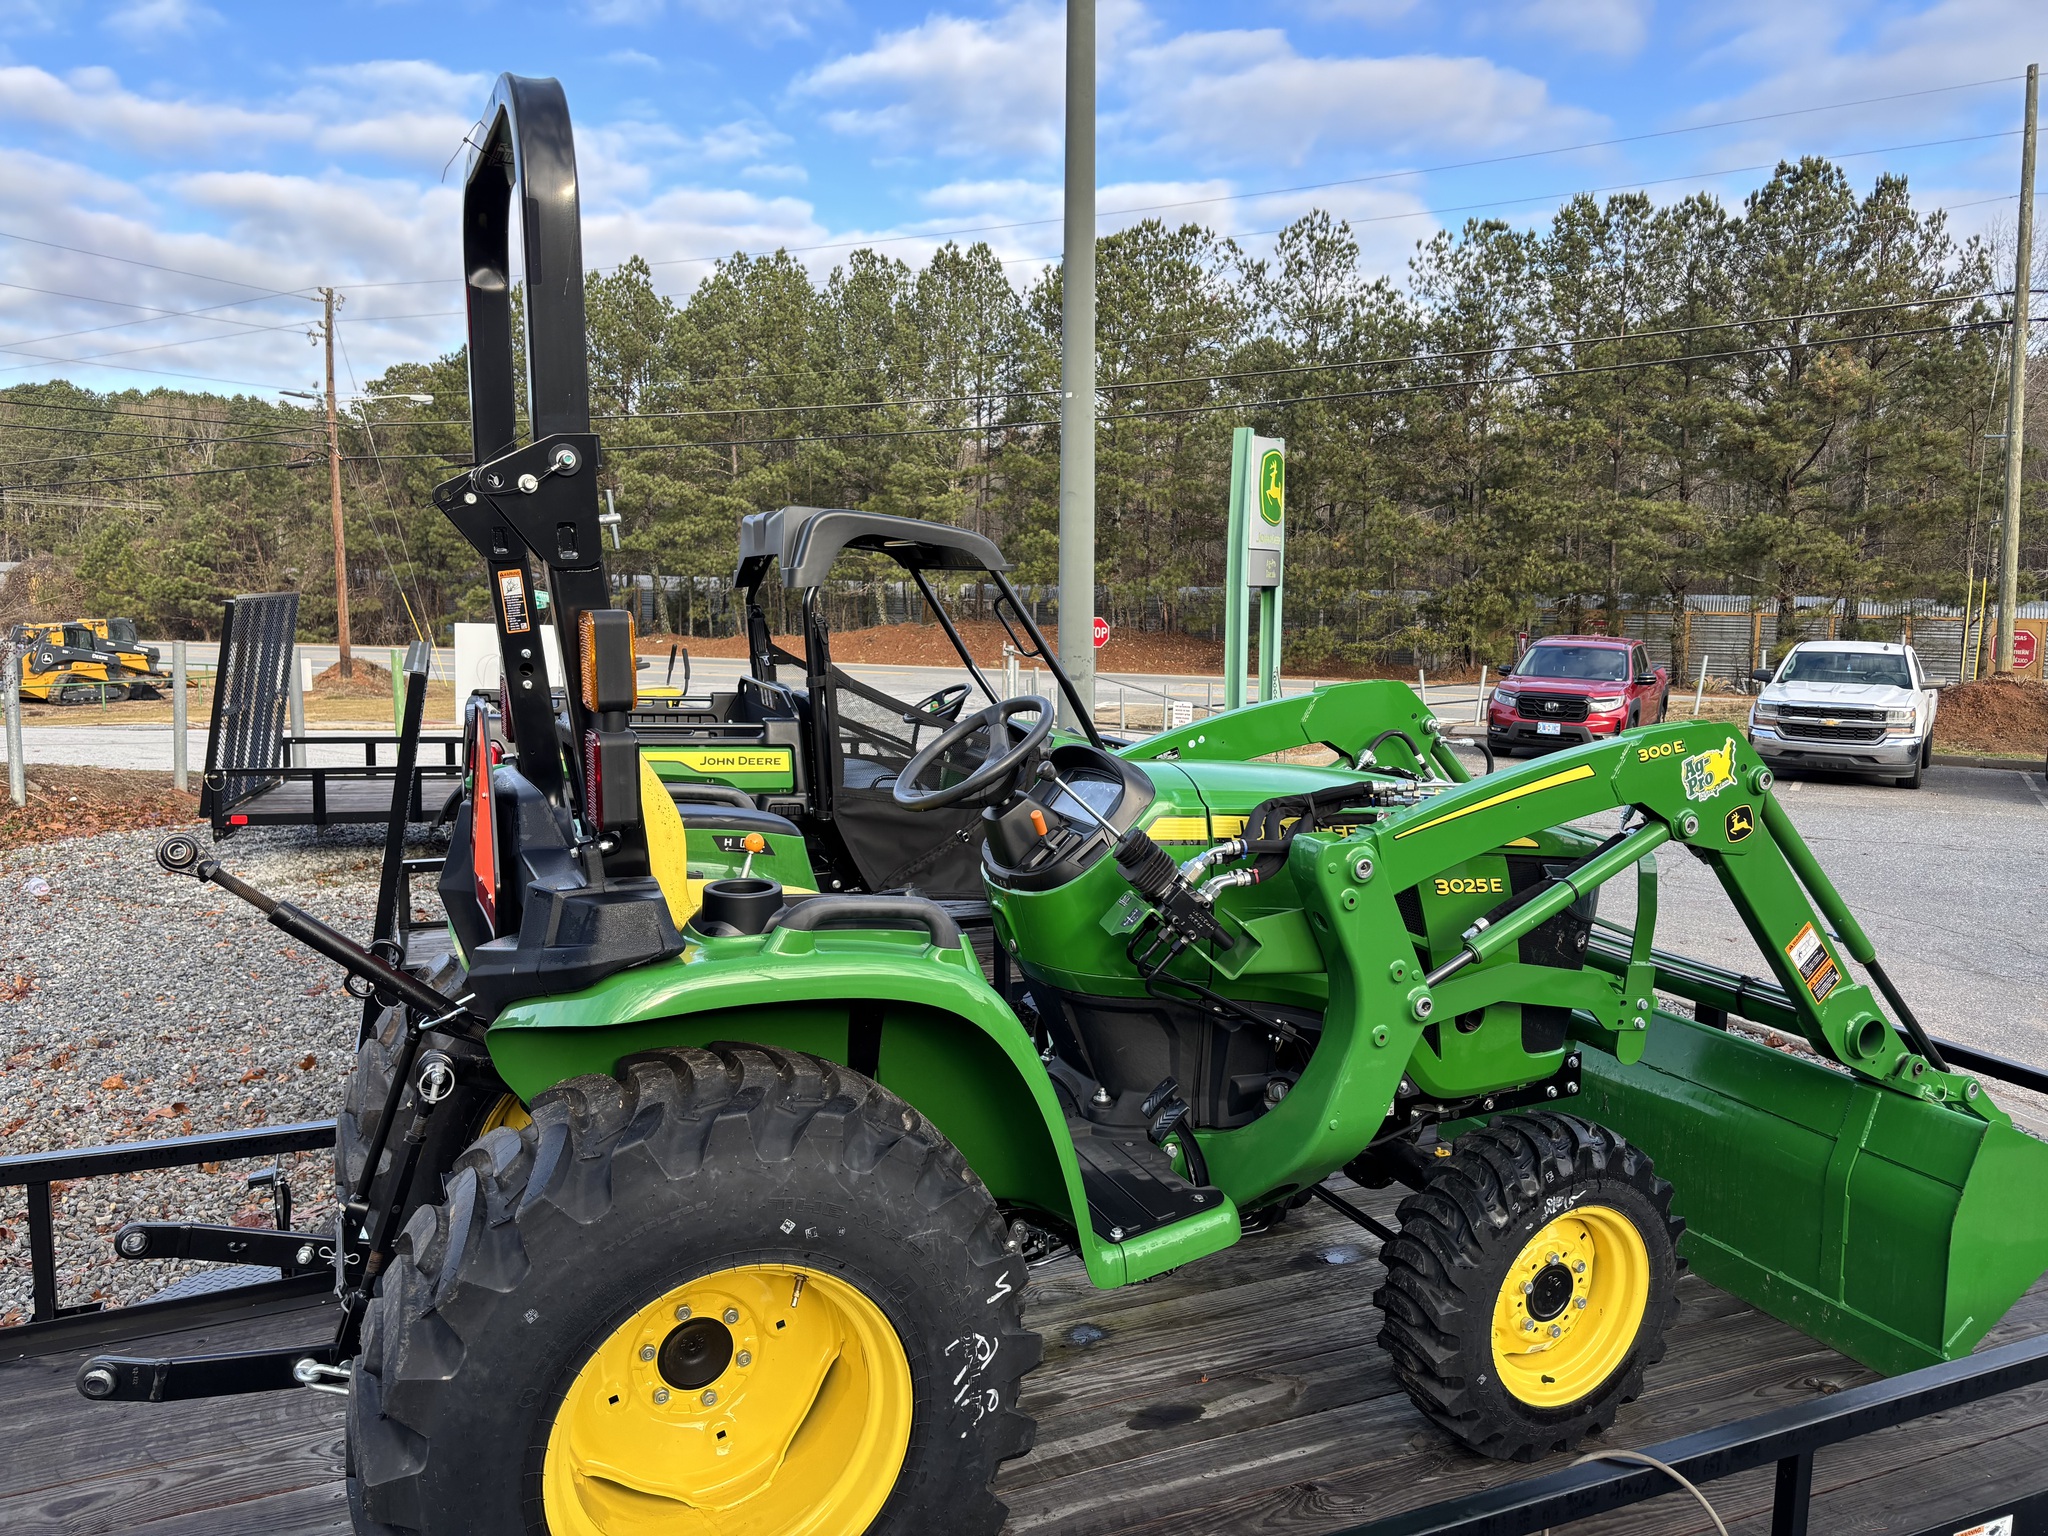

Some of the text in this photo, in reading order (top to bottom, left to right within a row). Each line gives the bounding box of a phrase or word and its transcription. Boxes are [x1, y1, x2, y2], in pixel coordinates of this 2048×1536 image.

[1093, 627, 1107, 639] OP
[700, 756, 781, 766] JOHN DEERE
[1687, 772, 1714, 797] Pro
